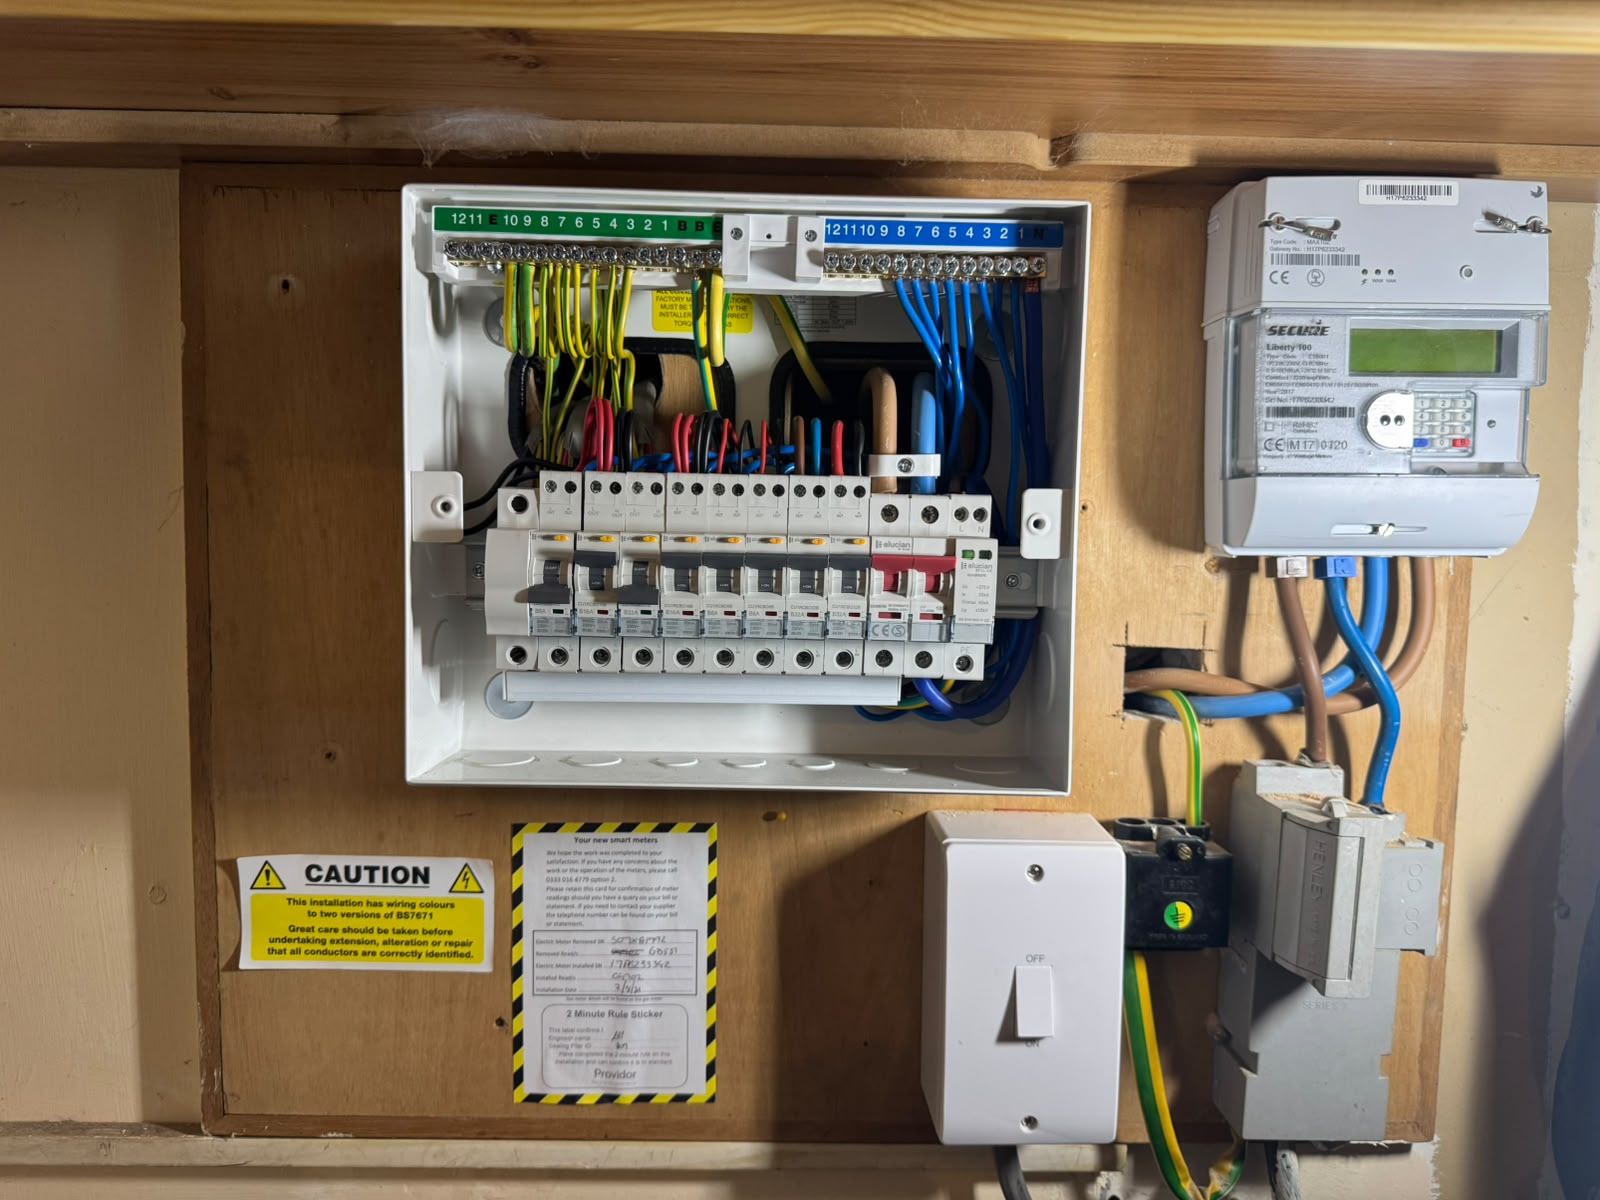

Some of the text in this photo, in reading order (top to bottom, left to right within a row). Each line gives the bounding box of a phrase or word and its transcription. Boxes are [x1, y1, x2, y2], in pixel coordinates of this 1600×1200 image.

[452, 214, 466, 224] 12
[470, 214, 482, 224] 11
[489, 214, 497, 224] E
[504, 215, 518, 226] 10
[524, 216, 532, 226] 9
[541, 216, 548, 226] 8
[558, 216, 566, 227] 7
[576, 216, 583, 228] 6
[592, 217, 600, 228] 5
[610, 218, 618, 228] 4
[627, 218, 635, 230] 3
[644, 219, 652, 230] 2
[662, 220, 668, 230] 1
[678, 220, 687, 232] B
[696, 220, 704, 232] B
[826, 224, 1044, 240] 12 11 10 9 8 7 6 5 4 3 2 1 N
[1266, 326, 1330, 336] SECURE
[1266, 344, 1295, 352] Liberty
[1321, 440, 1348, 450] 0120
[305, 864, 430, 884] CAUTION
[286, 898, 307, 906] This
[310, 898, 363, 907] installation
[366, 900, 383, 908] has
[386, 900, 416, 909] wiring
[396, 912, 433, 920] BS7671
[288, 924, 315, 933] Great
[342, 926, 374, 934] should
[422, 928, 453, 936] before
[269, 936, 326, 945] undertaking
[330, 938, 379, 946] extension,
[382, 938, 428, 946] alteration
[444, 939, 473, 948] repair
[304, 948, 358, 956] conductors
[380, 950, 422, 959] correctly
[1026, 954, 1045, 963] OFF
[567, 1009, 663, 1019] 2 Minute Rule Sticker
[594, 1068, 636, 1079] Providor
